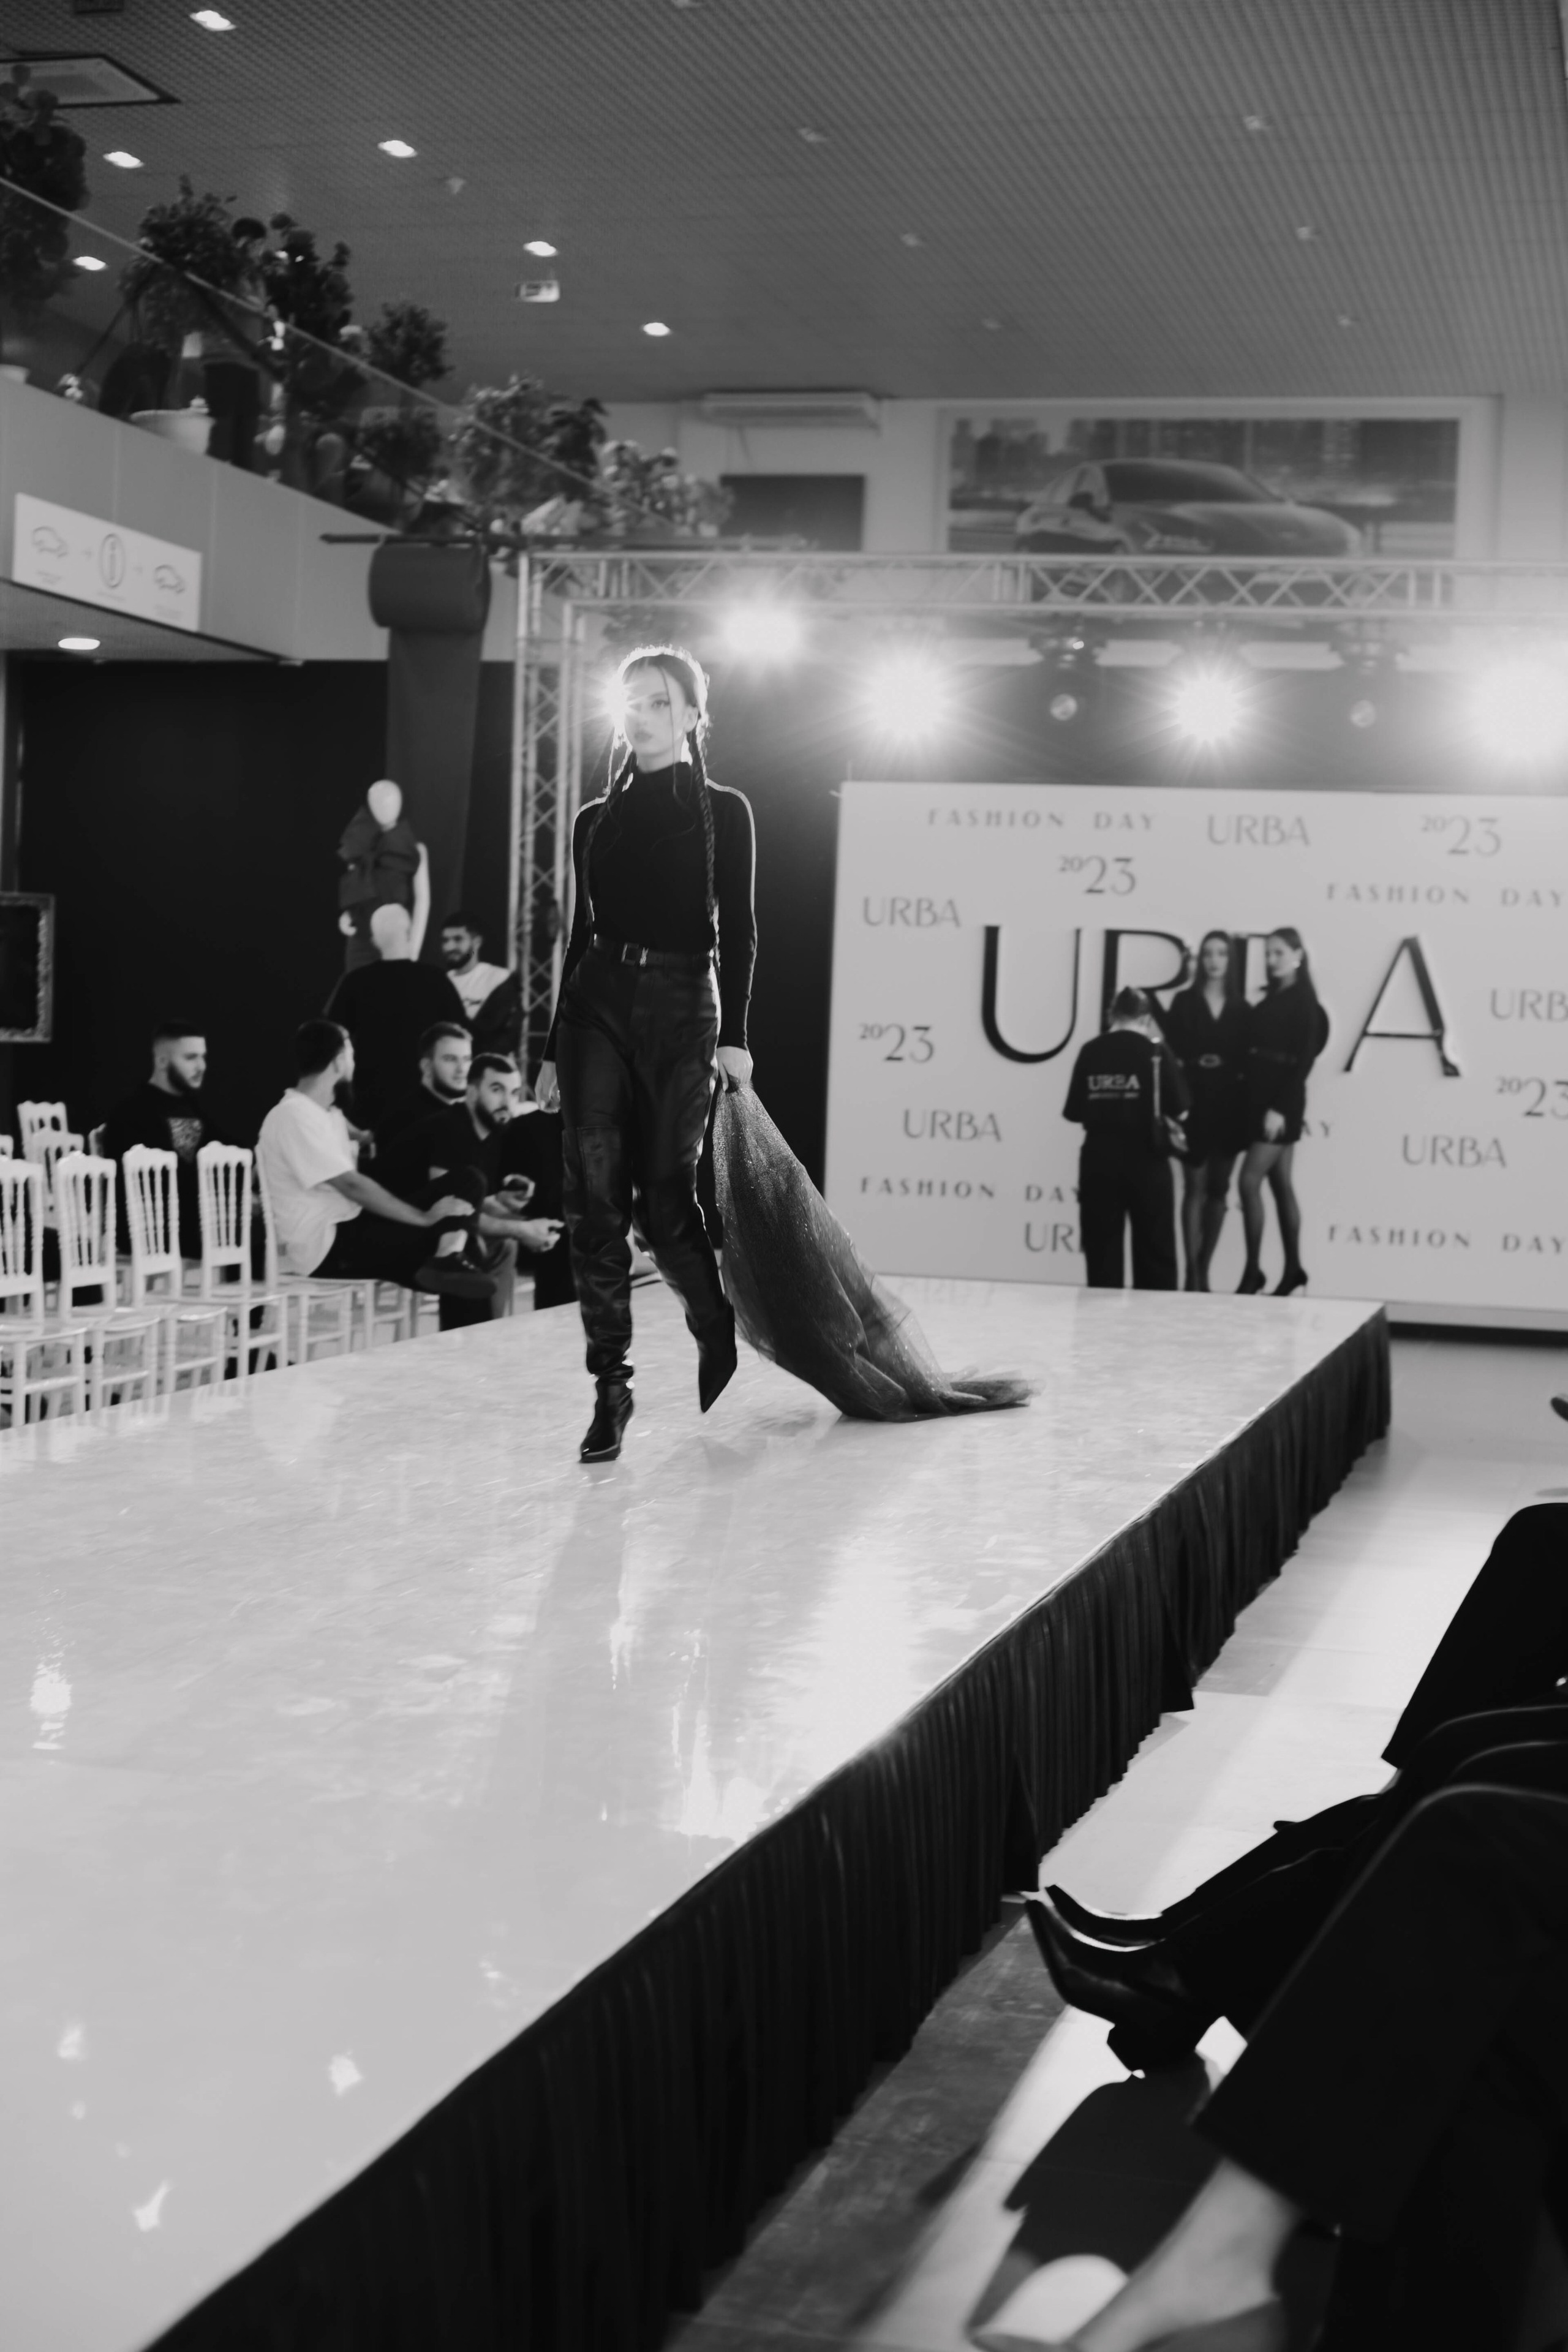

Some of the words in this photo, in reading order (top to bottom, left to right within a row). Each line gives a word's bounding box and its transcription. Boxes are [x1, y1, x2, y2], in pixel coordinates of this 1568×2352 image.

[927, 808, 1065, 829] FASHION
[1093, 811, 1155, 832] DAY
[1206, 813, 1311, 848] URBA
[1420, 814, 1503, 858] 2023
[1057, 853, 1139, 897] 2023
[861, 895, 962, 930] URBA
[1325, 882, 1470, 905] FASHION
[1500, 887, 1566, 908] DAY
[1489, 987, 1568, 1023] URB
[858, 1022, 937, 1065] 2023
[902, 1107, 1003, 1144] URBA
[1400, 1133, 1508, 1169] URBA
[859, 1175, 996, 1200] FASHION
[1025, 1222, 1082, 1253] UR
[1327, 1223, 1471, 1250] FASHION
[1501, 1232, 1567, 1256] DAY
